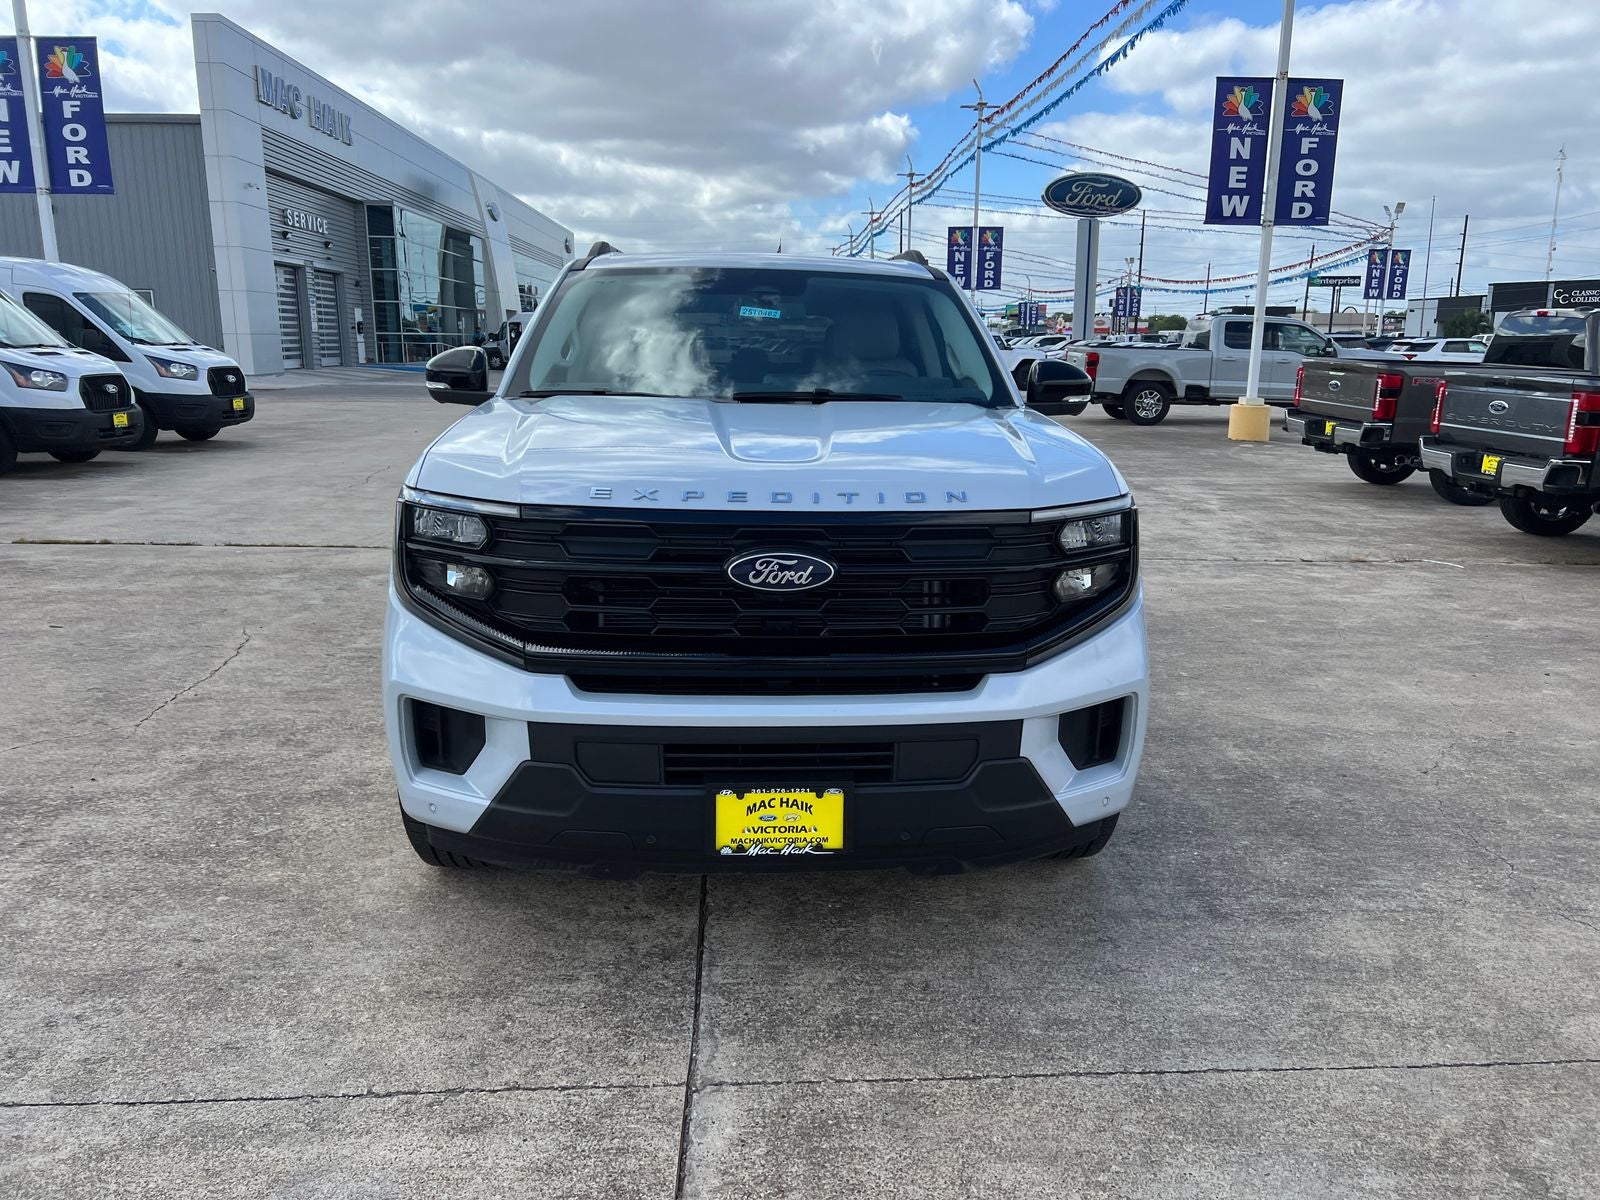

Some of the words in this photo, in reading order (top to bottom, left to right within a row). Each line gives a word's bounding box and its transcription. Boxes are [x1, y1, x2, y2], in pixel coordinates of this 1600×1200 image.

[254, 65, 302, 119] MAC
[308, 95, 353, 146] HAIK
[62, 101, 92, 187] FORD
[1221, 137, 1251, 217] NEW
[1291, 137, 1319, 219] FORD
[1065, 181, 1123, 206] Ford
[287, 209, 328, 234] SERVICE
[984, 251, 995, 288] FORD
[1369, 268, 1380, 298] NEW
[1393, 269, 1402, 298] FORD
[589, 487, 968, 504] EXPEDITION
[748, 558, 814, 585] Ford
[746, 797, 776, 816] MAC
[780, 797, 813, 815] HAIK
[752, 826, 808, 834] VICTORIA
[744, 843, 779, 856] Mac
[780, 843, 822, 856] Haik
